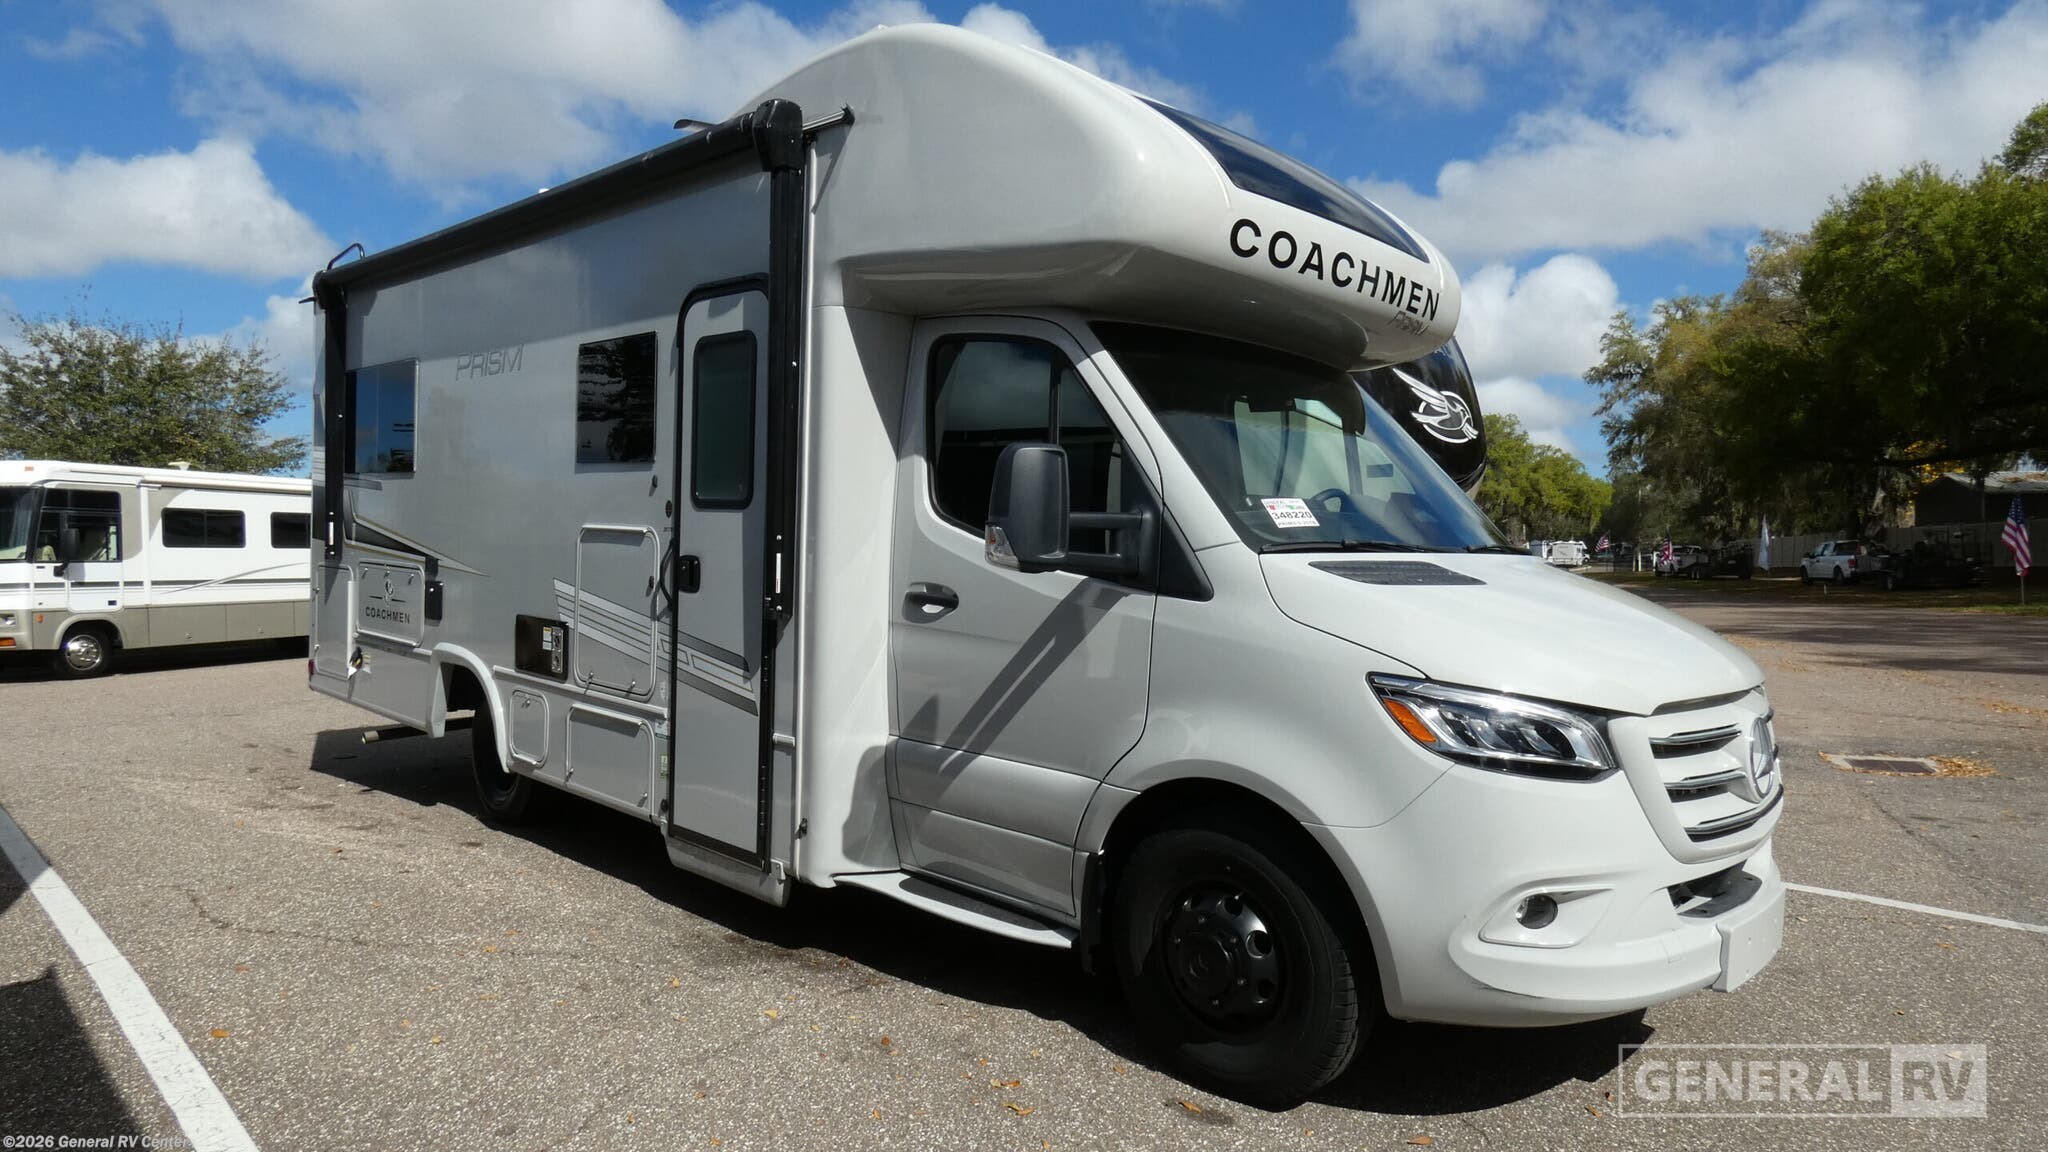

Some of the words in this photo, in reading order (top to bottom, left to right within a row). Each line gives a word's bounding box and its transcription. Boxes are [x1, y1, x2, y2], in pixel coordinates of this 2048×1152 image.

[1230, 218, 1440, 321] COACHMEN
[455, 344, 523, 381] PRISM
[365, 606, 411, 625] COACHMEN
